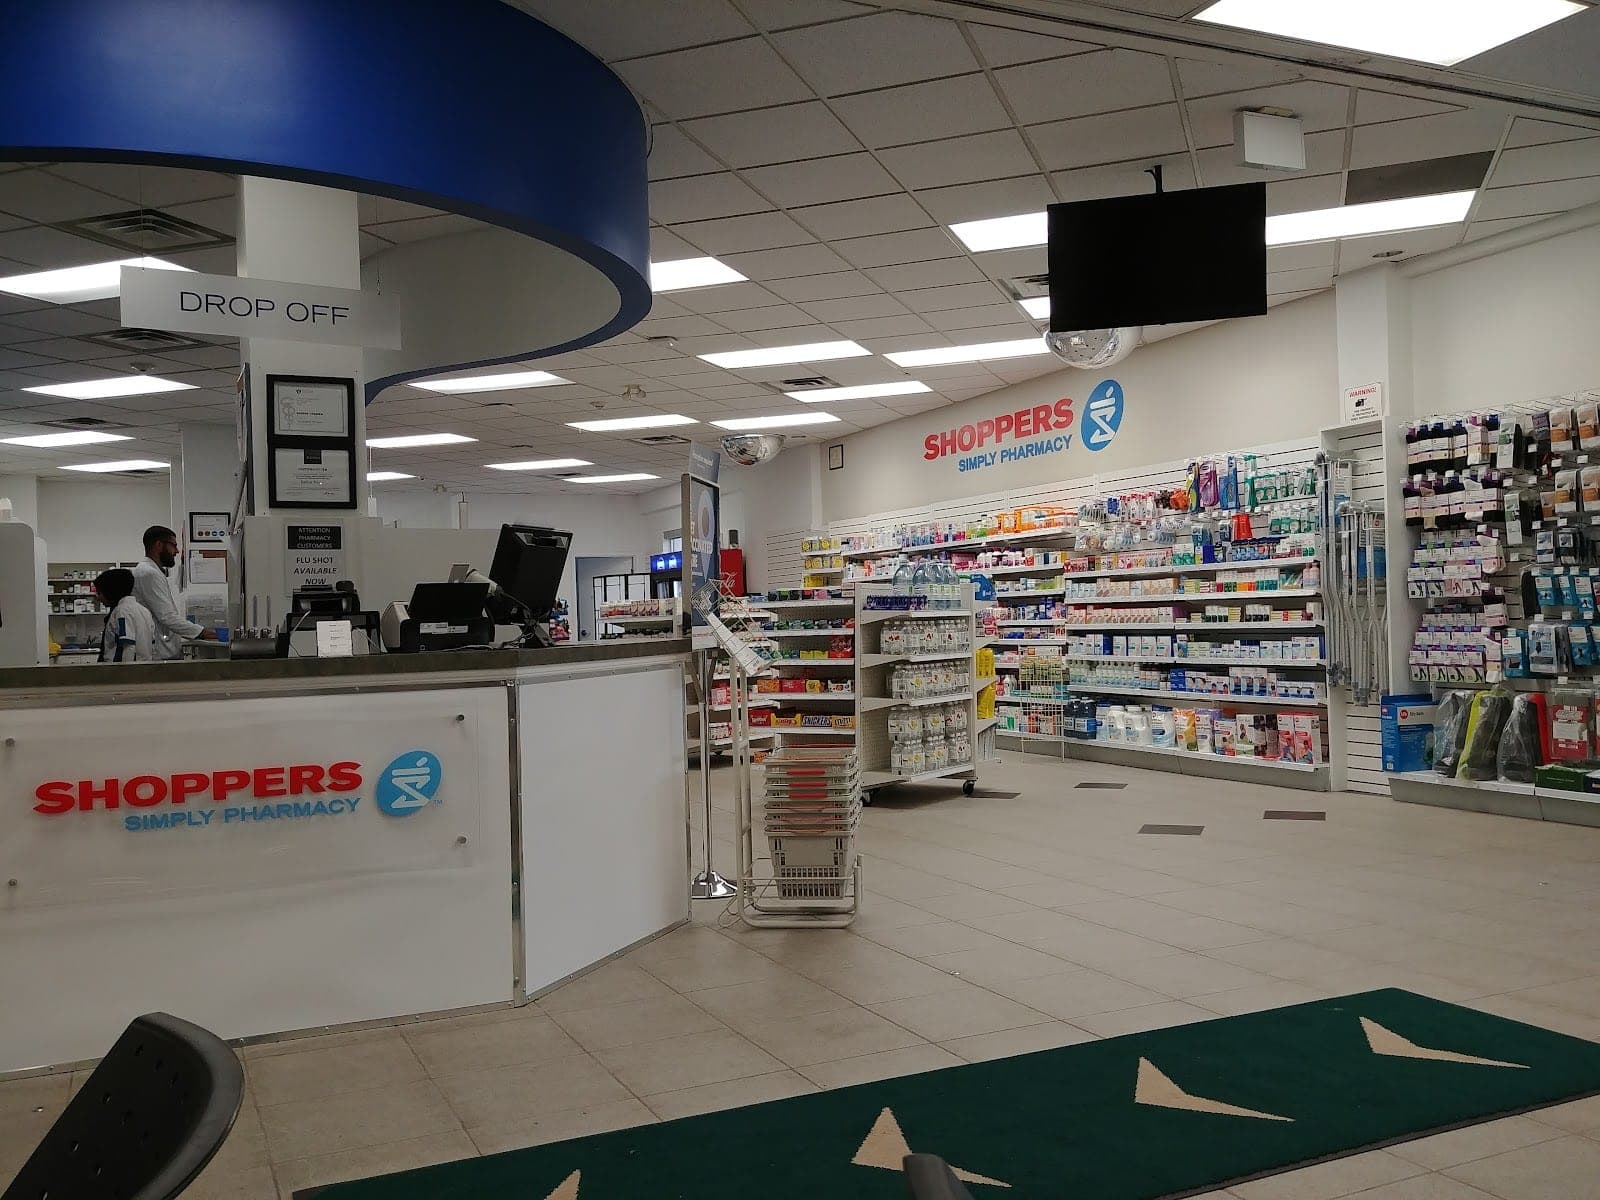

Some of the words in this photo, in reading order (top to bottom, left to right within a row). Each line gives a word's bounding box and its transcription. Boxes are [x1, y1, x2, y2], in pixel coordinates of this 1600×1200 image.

[180, 291, 275, 318] DROP
[286, 302, 350, 325] OFF
[923, 397, 1074, 461] SHOPPERS
[958, 451, 997, 473] SIMPLY
[1000, 434, 1073, 464] PHARMACY
[294, 567, 337, 575] AVAILABLE
[33, 760, 364, 816] SHOPPERS
[124, 808, 216, 832] SIMPLY
[223, 797, 362, 824] PHARMACY
